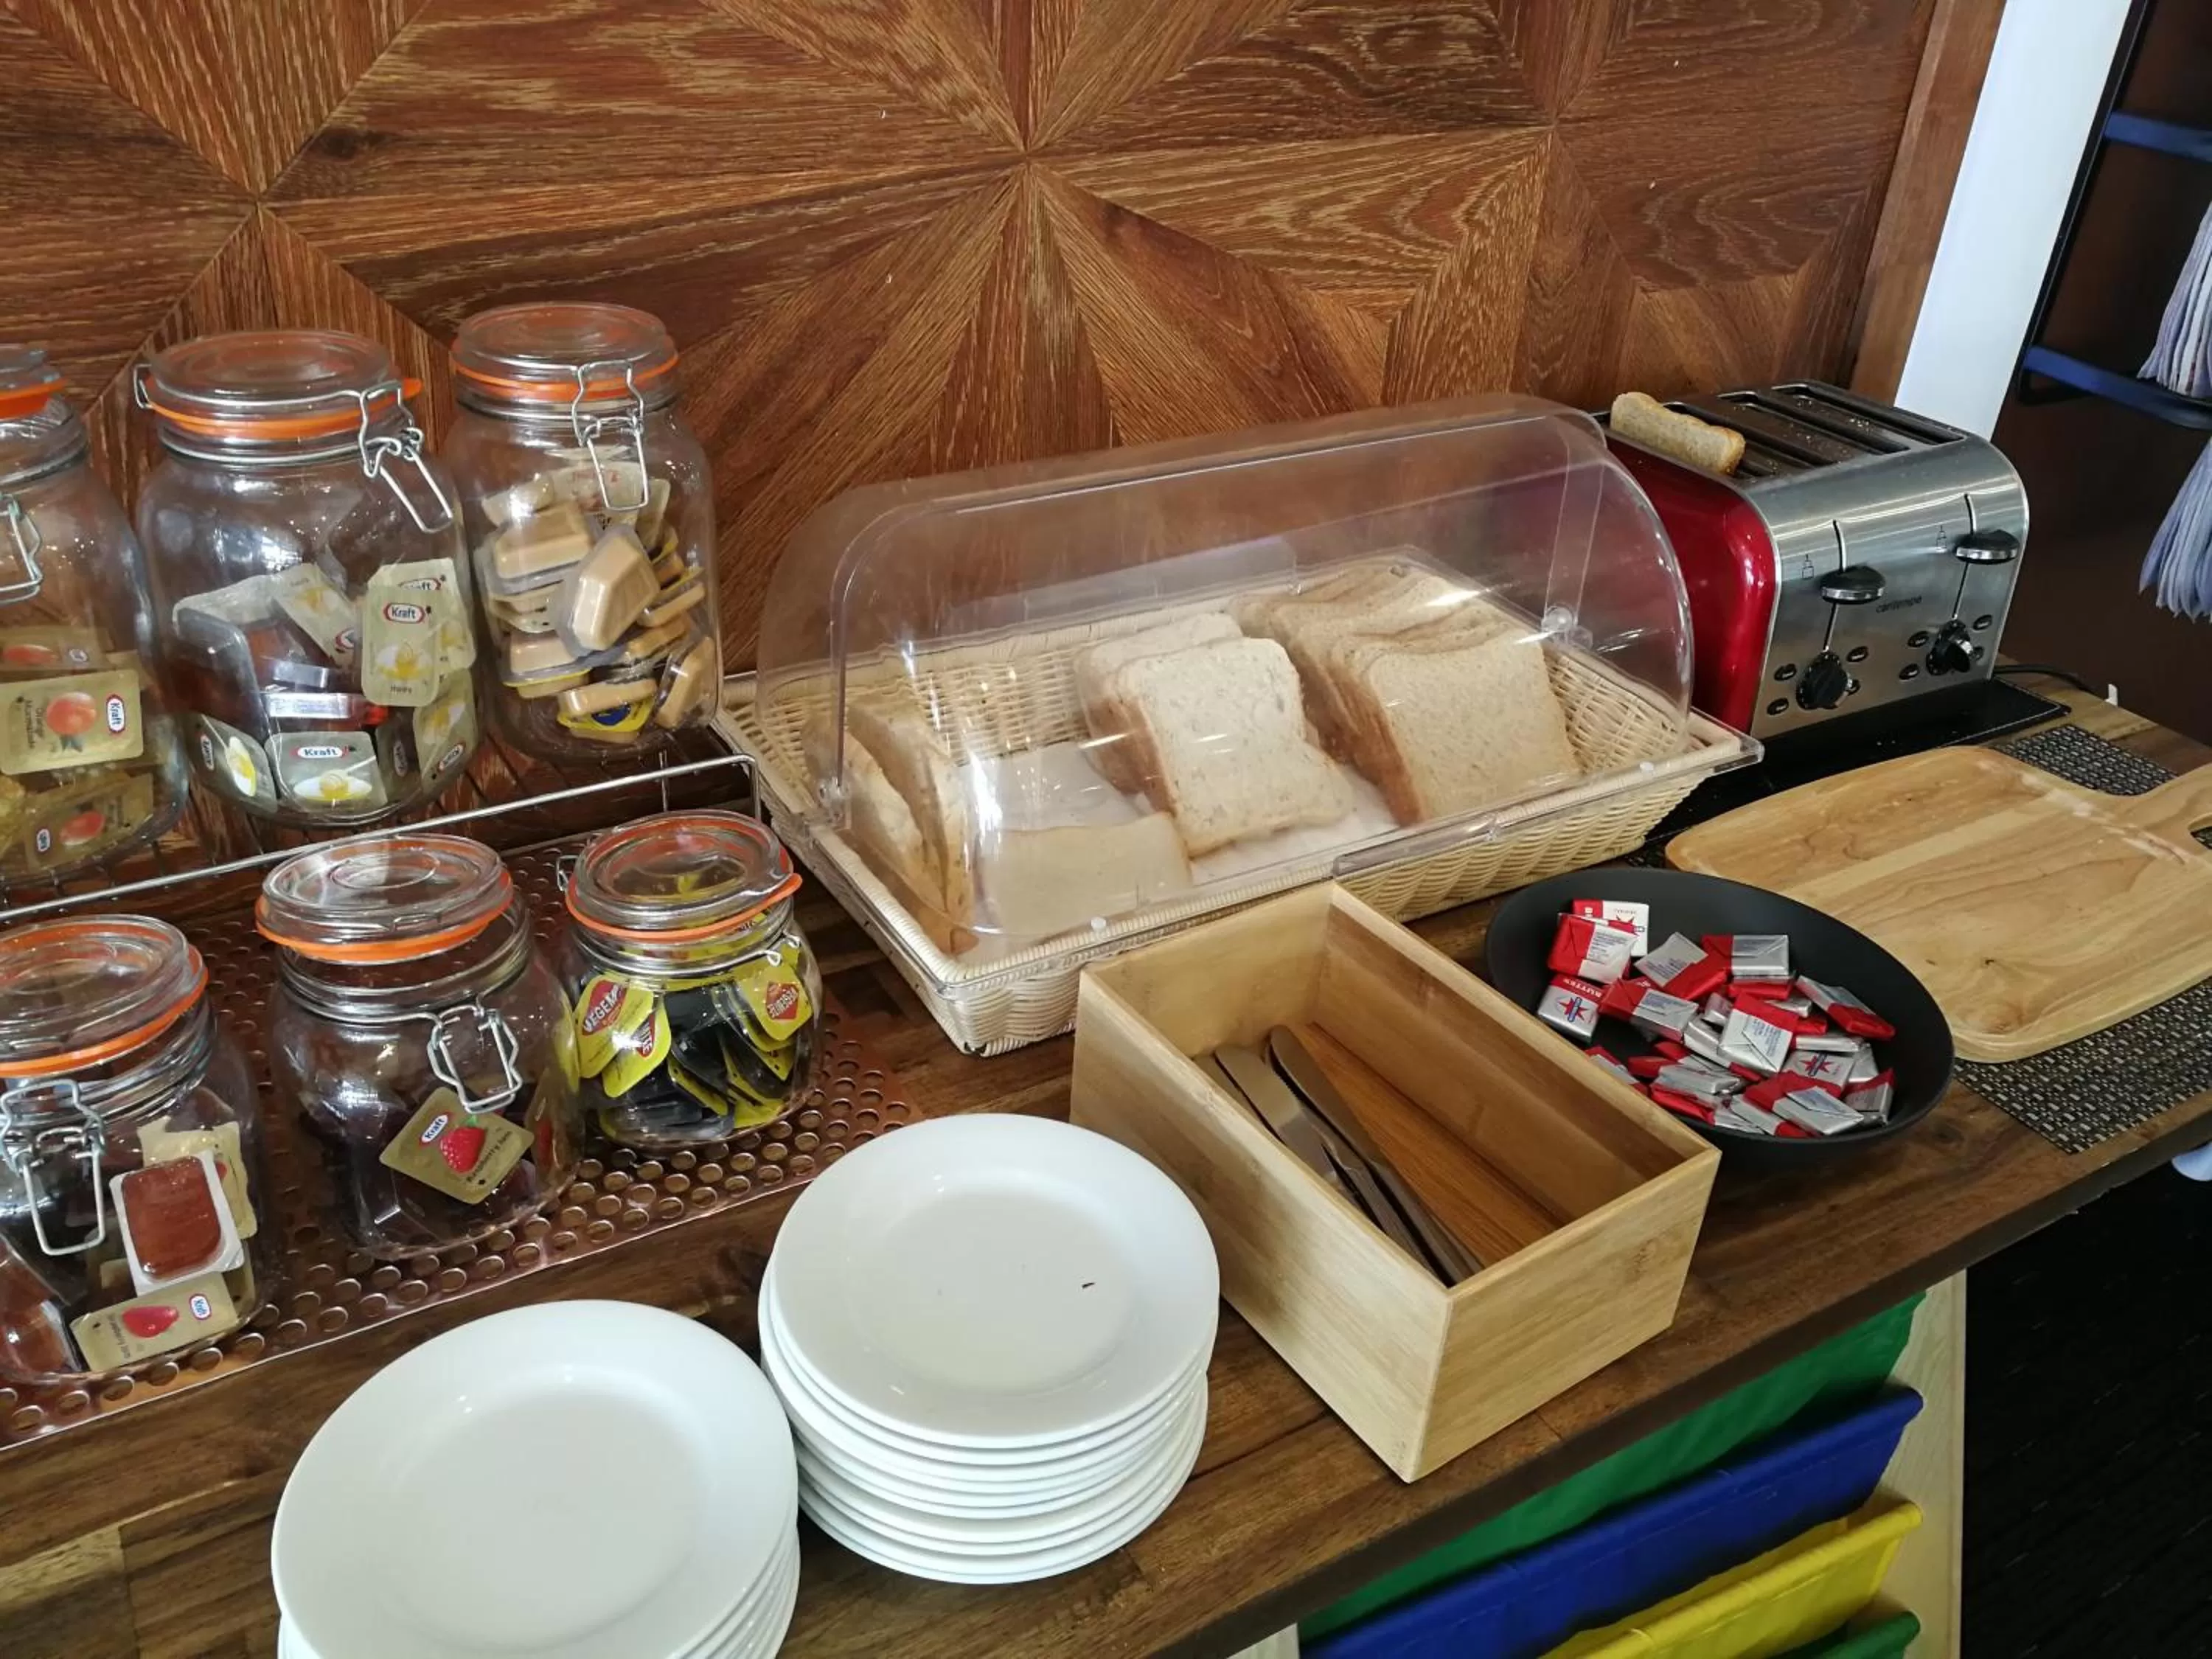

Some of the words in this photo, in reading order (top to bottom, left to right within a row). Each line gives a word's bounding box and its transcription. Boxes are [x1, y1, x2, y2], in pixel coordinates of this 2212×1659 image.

[391, 605, 416, 619] Kraft
[111, 702, 122, 726] Kraft
[303, 748, 338, 757] Kraft
[424, 1118, 445, 1139] Kraft
